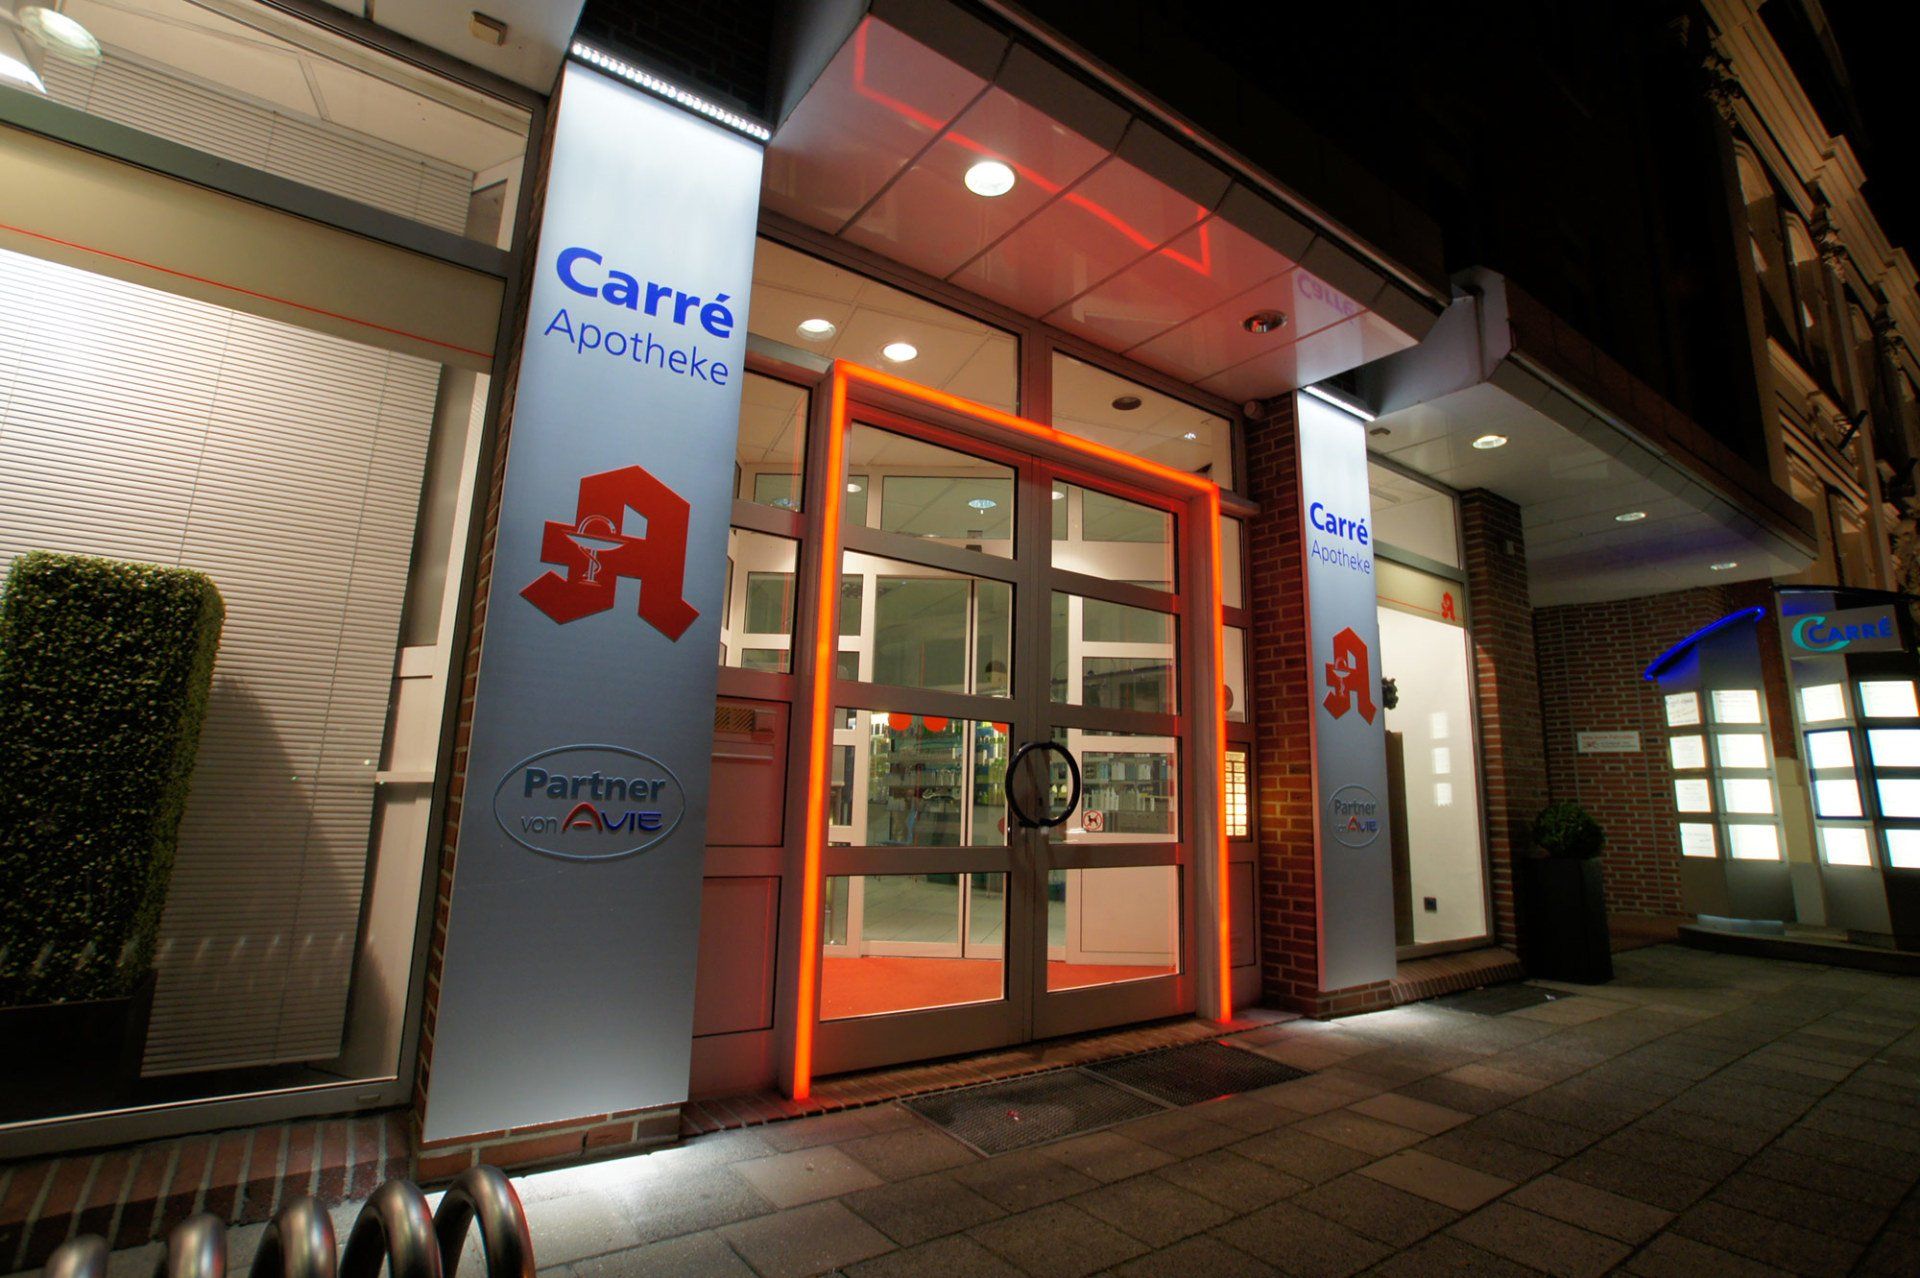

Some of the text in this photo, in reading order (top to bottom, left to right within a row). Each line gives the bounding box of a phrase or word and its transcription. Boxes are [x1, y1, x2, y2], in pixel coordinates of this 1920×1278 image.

[556, 246, 734, 339] Carré
[544, 308, 729, 386] Apotheke
[1310, 502, 1368, 545] Carré
[1312, 540, 1370, 574] Apotheke
[1808, 616, 1892, 643] CARRÉ
[524, 766, 666, 801] Partner
[521, 801, 664, 834] von AVIE
[1334, 799, 1376, 816] Partner
